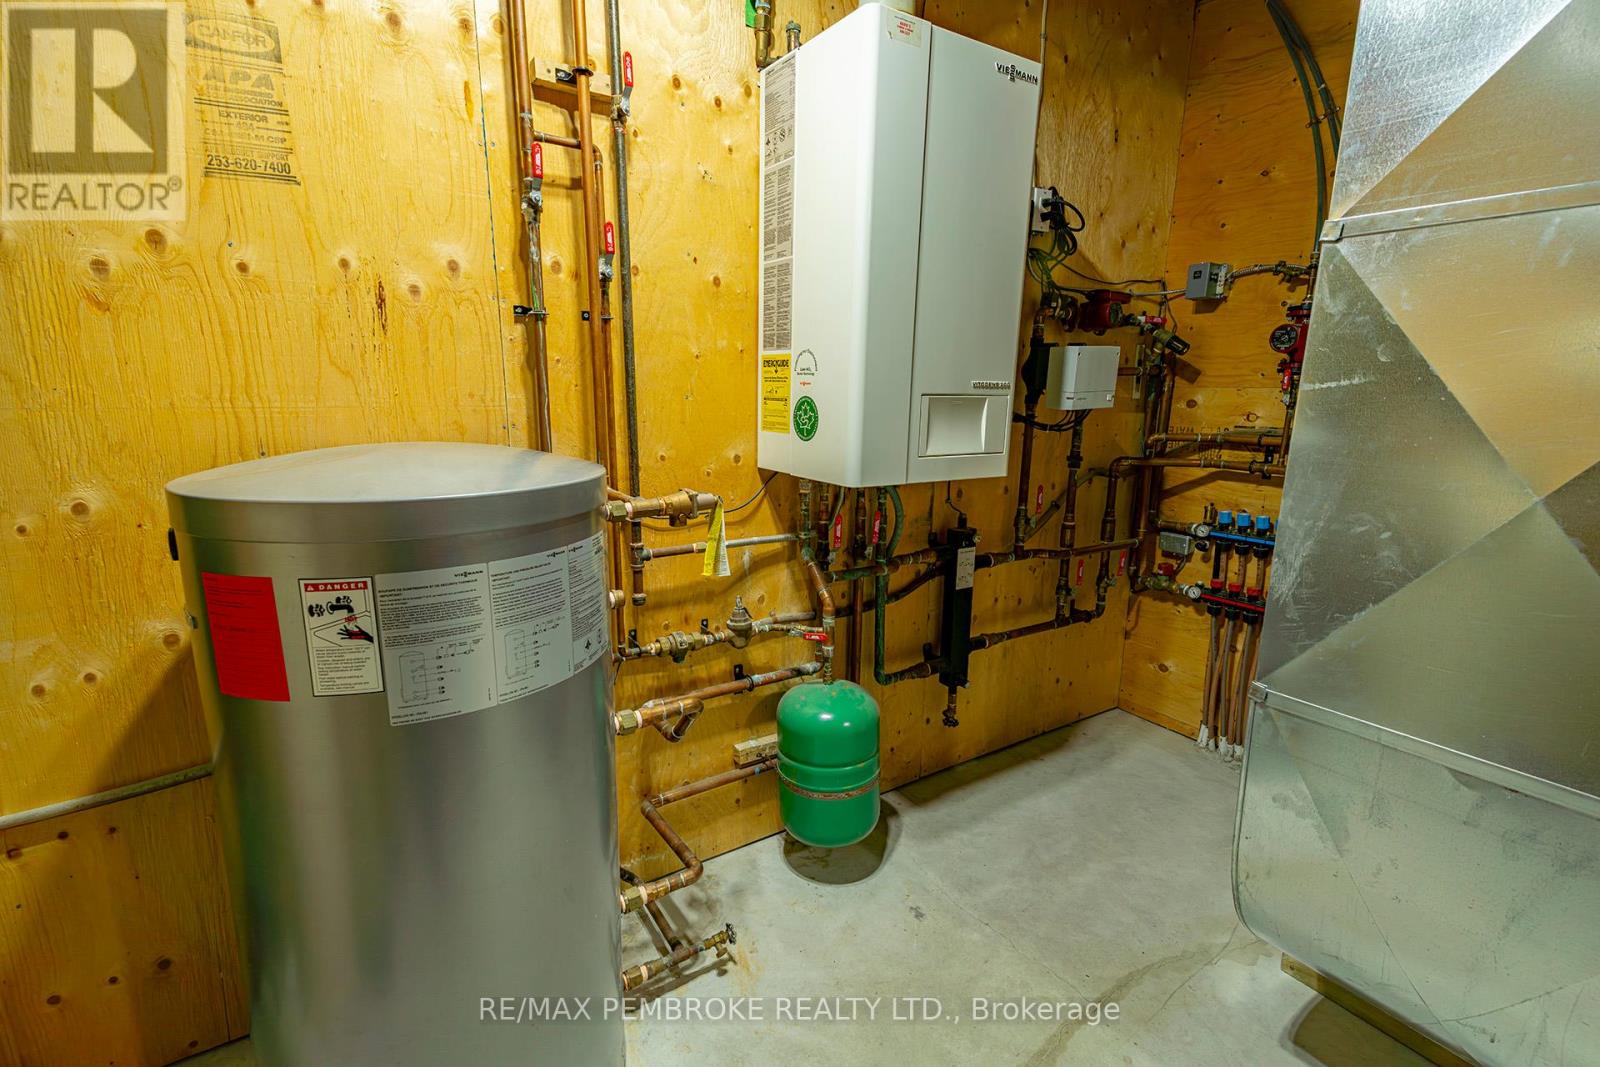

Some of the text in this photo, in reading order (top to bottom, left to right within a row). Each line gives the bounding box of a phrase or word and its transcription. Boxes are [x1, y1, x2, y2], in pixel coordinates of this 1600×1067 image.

[202, 63, 275, 91] APA
[996, 62, 1038, 83] VIESSMANN
[218, 110, 269, 123] EXTERIOR
[206, 153, 291, 174] 253-620-7400
[318, 582, 364, 591] DANGER
